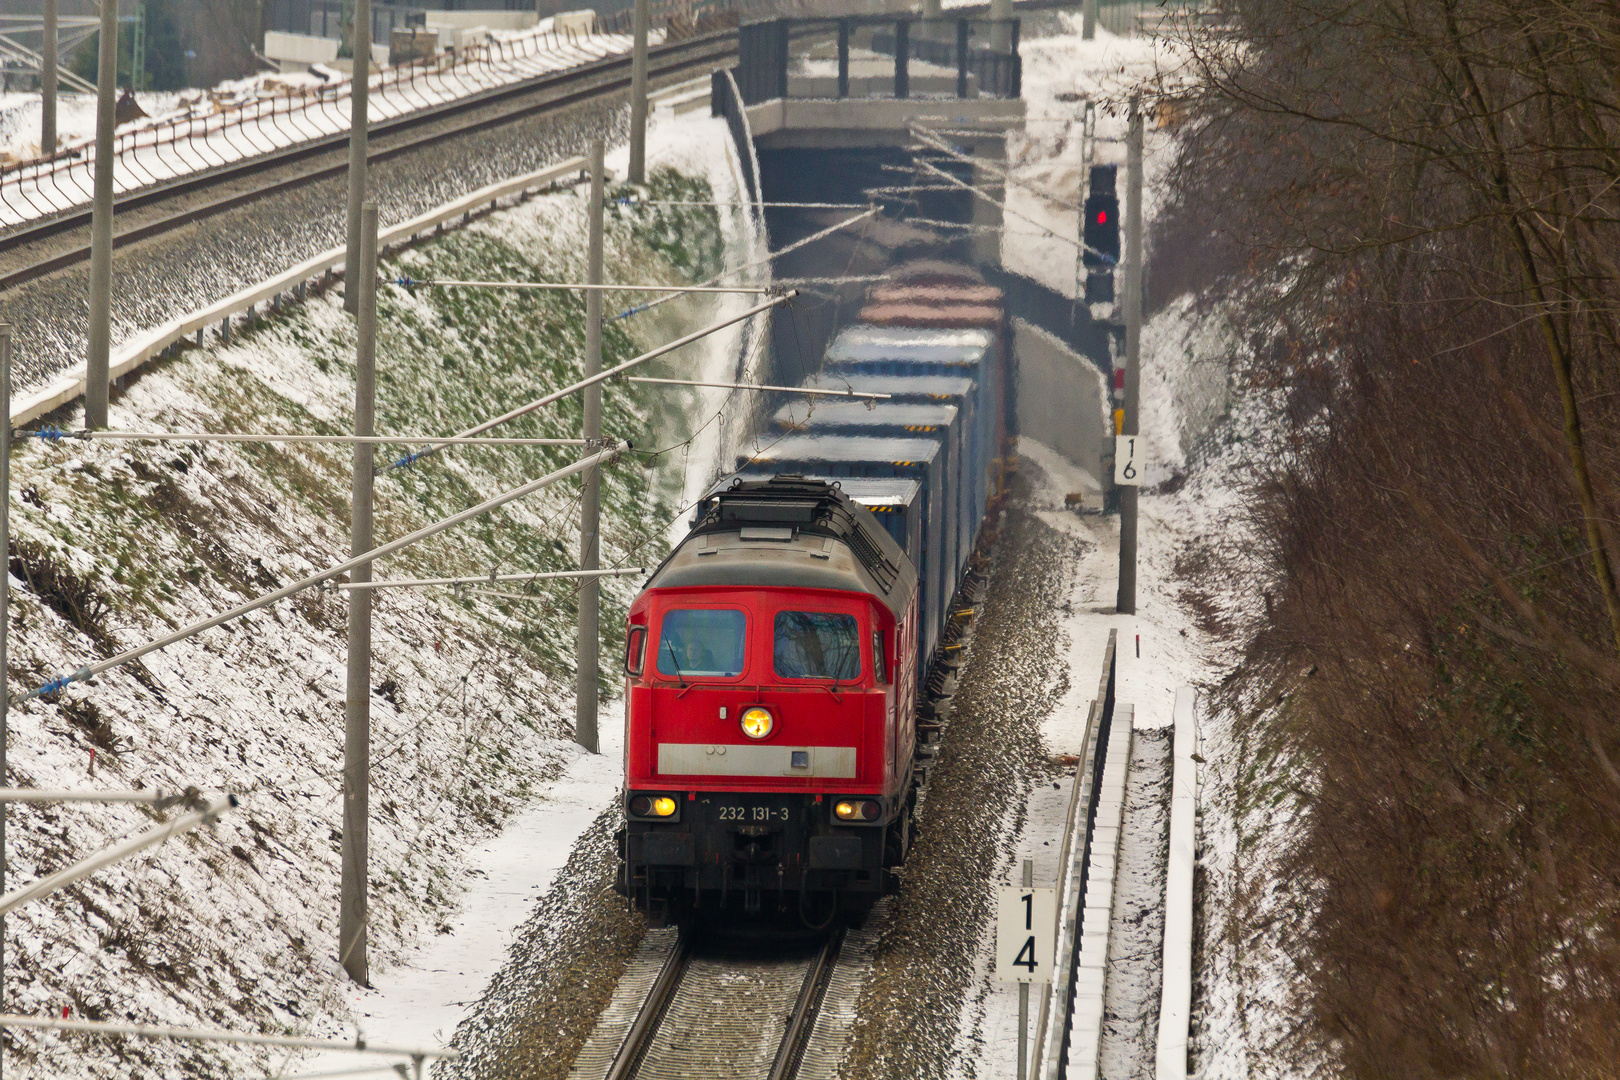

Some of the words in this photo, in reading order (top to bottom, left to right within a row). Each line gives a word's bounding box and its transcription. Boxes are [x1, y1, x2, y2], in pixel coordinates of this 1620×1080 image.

[1128, 438, 1135, 458] 1
[1122, 460, 1137, 480] 6
[719, 806, 745, 820] 232
[752, 807, 789, 821] 131-3
[1021, 893, 1033, 931] 1
[1013, 936, 1038, 974] 4
